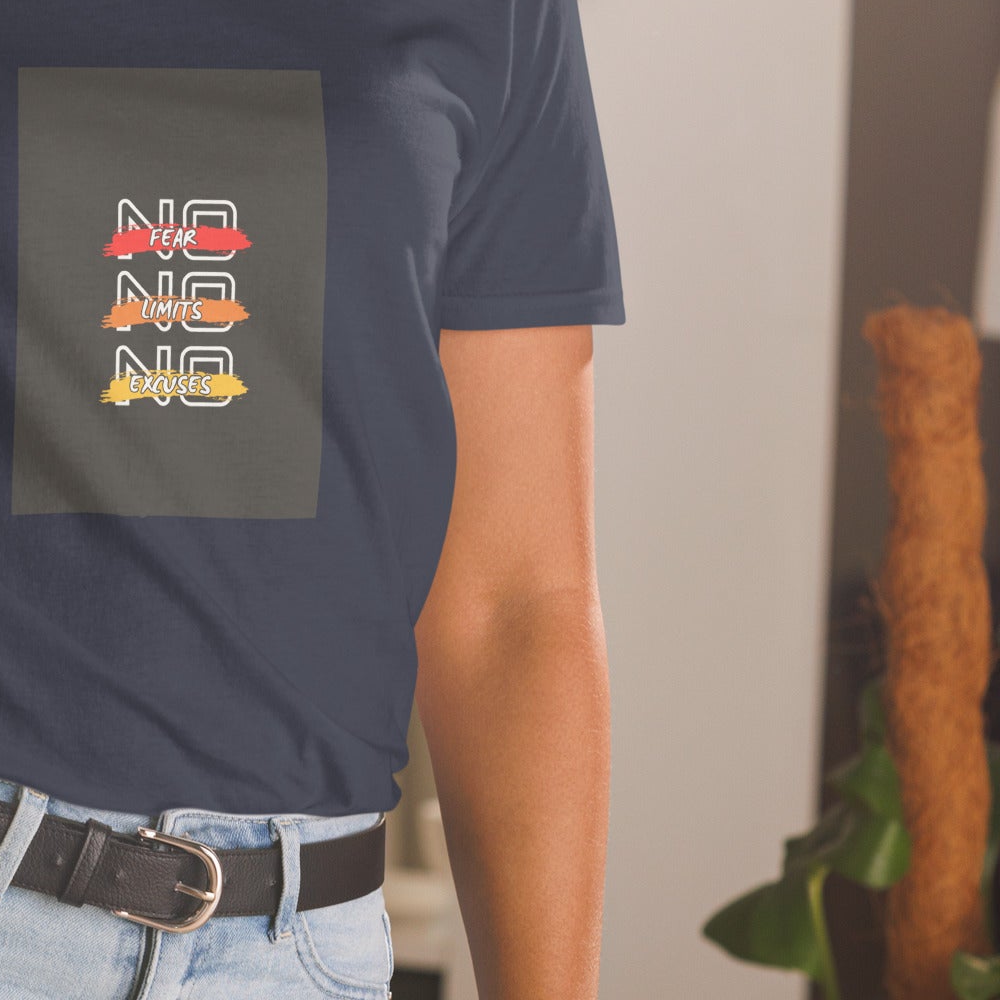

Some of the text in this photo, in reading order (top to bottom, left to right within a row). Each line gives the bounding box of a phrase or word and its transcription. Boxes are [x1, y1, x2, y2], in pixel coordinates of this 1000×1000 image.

[118, 199, 237, 261] NO
[150, 228, 198, 248] FEAR
[116, 271, 235, 332] NO
[141, 299, 203, 320] LIMITS
[115, 345, 233, 407] NO
[129, 375, 211, 394] EXCUSES
